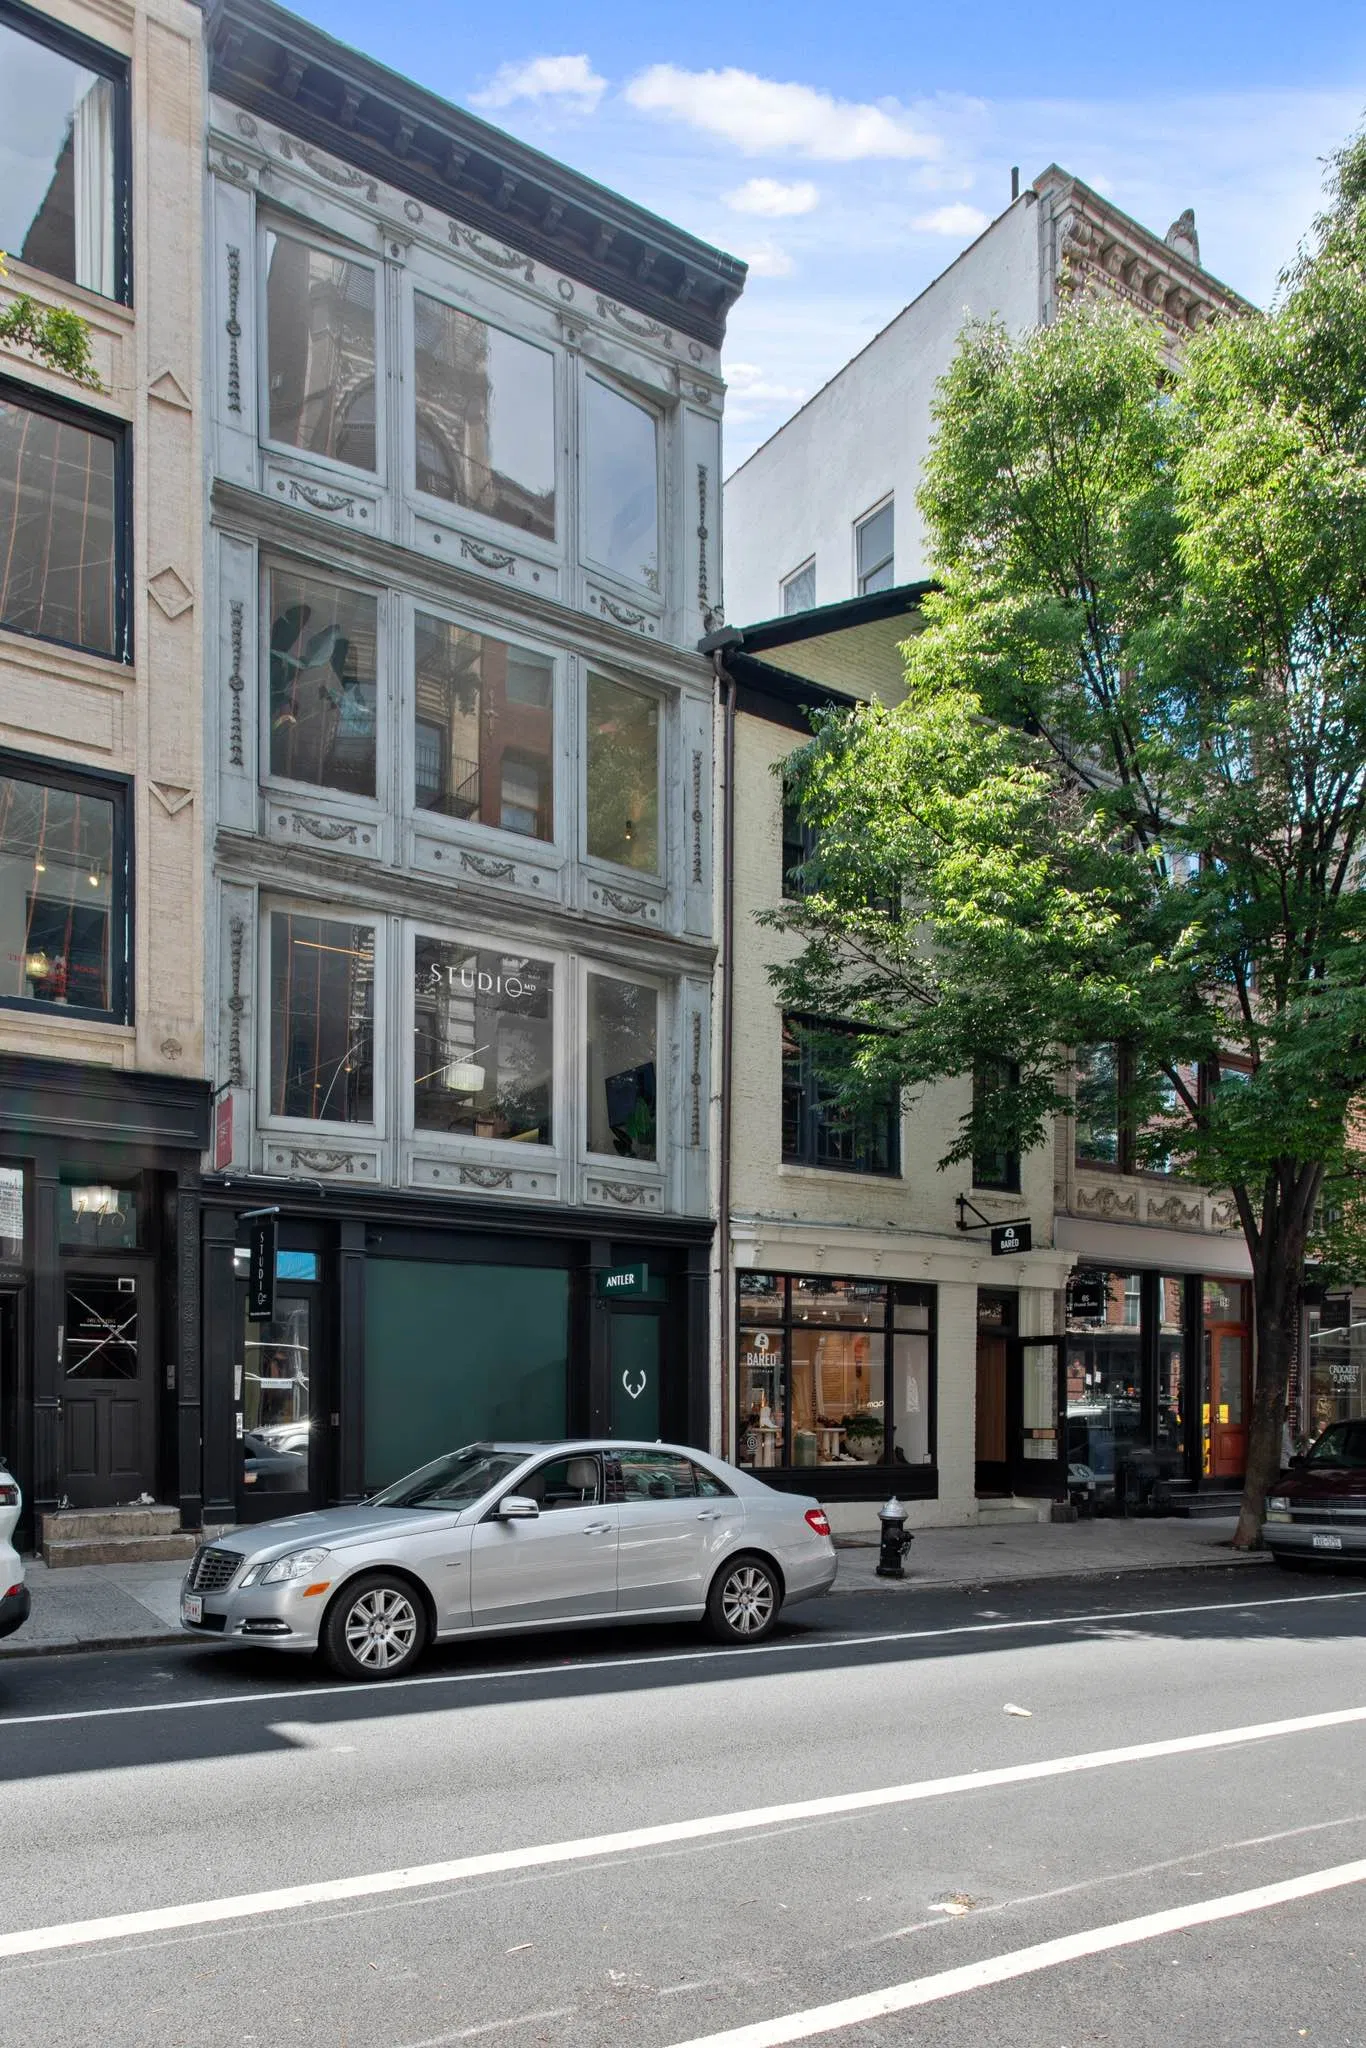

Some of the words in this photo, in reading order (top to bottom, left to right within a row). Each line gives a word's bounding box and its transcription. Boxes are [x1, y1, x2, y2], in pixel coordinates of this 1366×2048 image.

[430, 963, 523, 997] STUDIO
[524, 983, 536, 991] MD
[1000, 1238, 1020, 1249] BARED
[606, 1273, 635, 1287] ANTLER
[746, 1352, 776, 1367] BARED
[1329, 1365, 1360, 1375] CROCKETT
[1338, 1374, 1357, 1383] JONES
